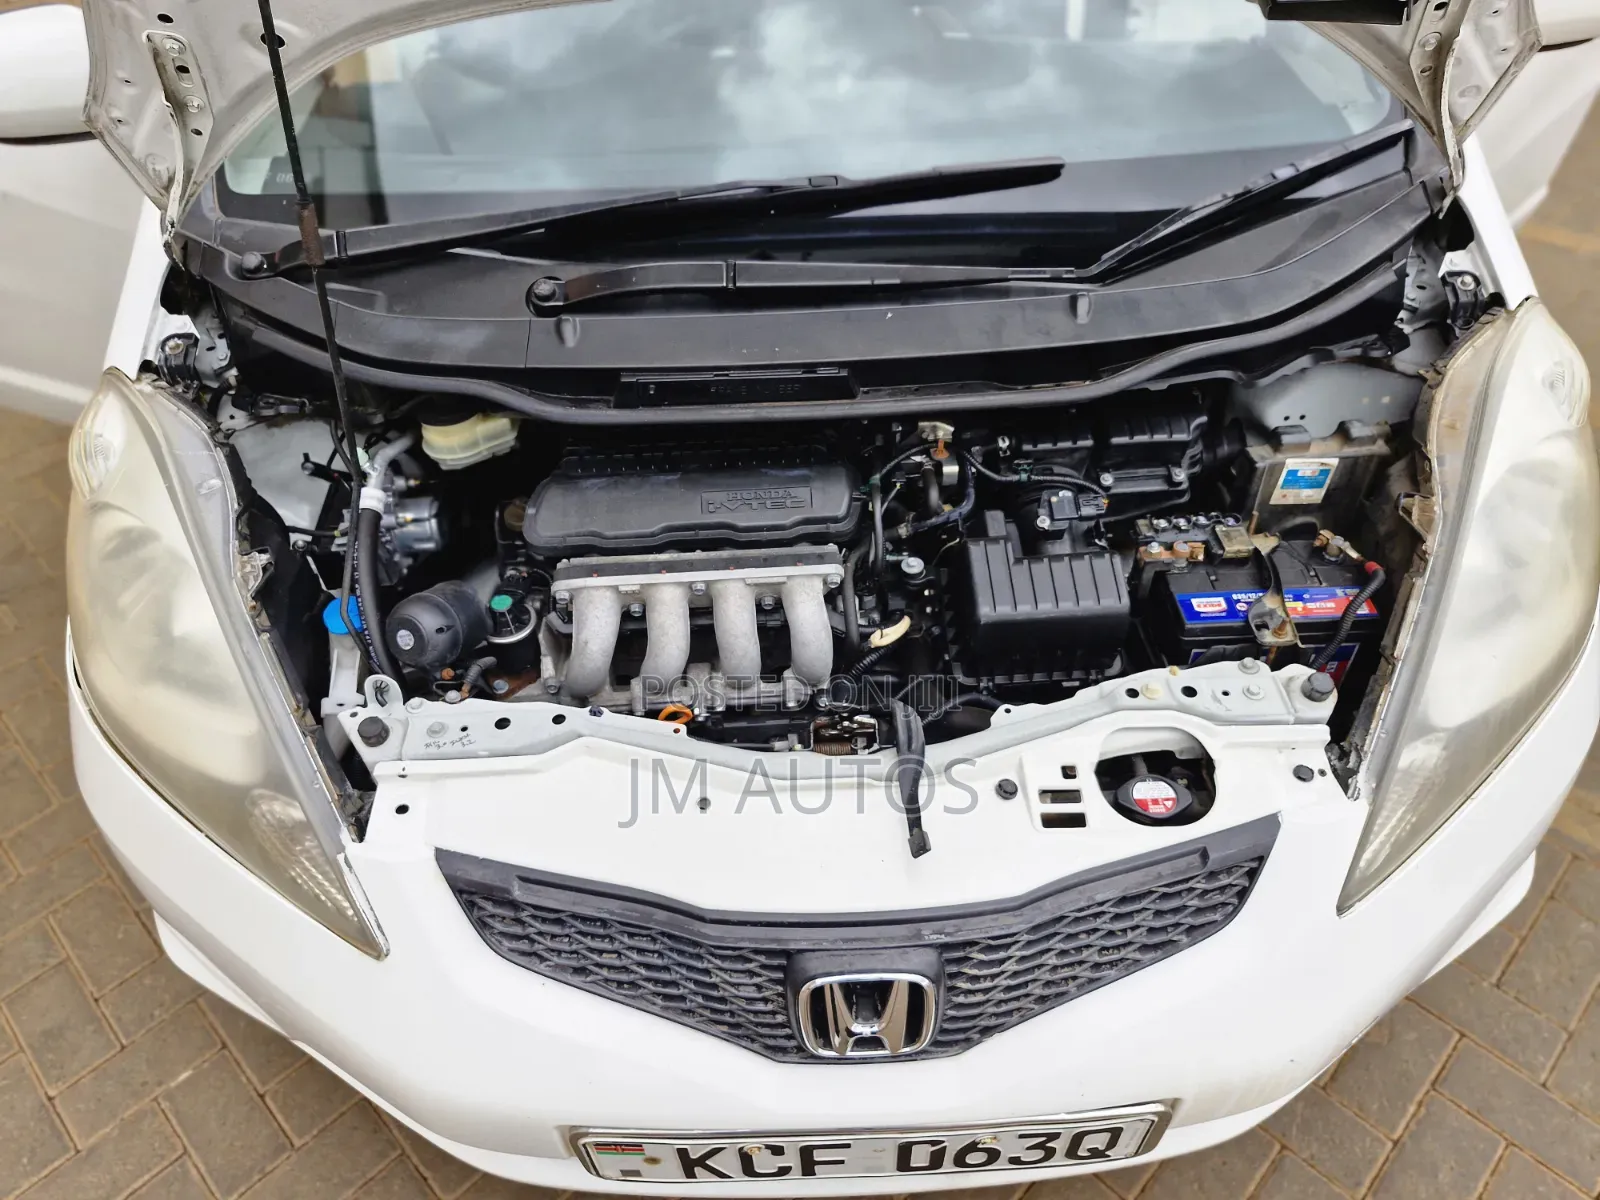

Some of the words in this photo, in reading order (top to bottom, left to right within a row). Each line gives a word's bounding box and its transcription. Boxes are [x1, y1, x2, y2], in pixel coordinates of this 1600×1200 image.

[726, 489, 798, 502] HONDA
[676, 1143, 852, 1180] KCF
[896, 1126, 1124, 1173] 063Q
